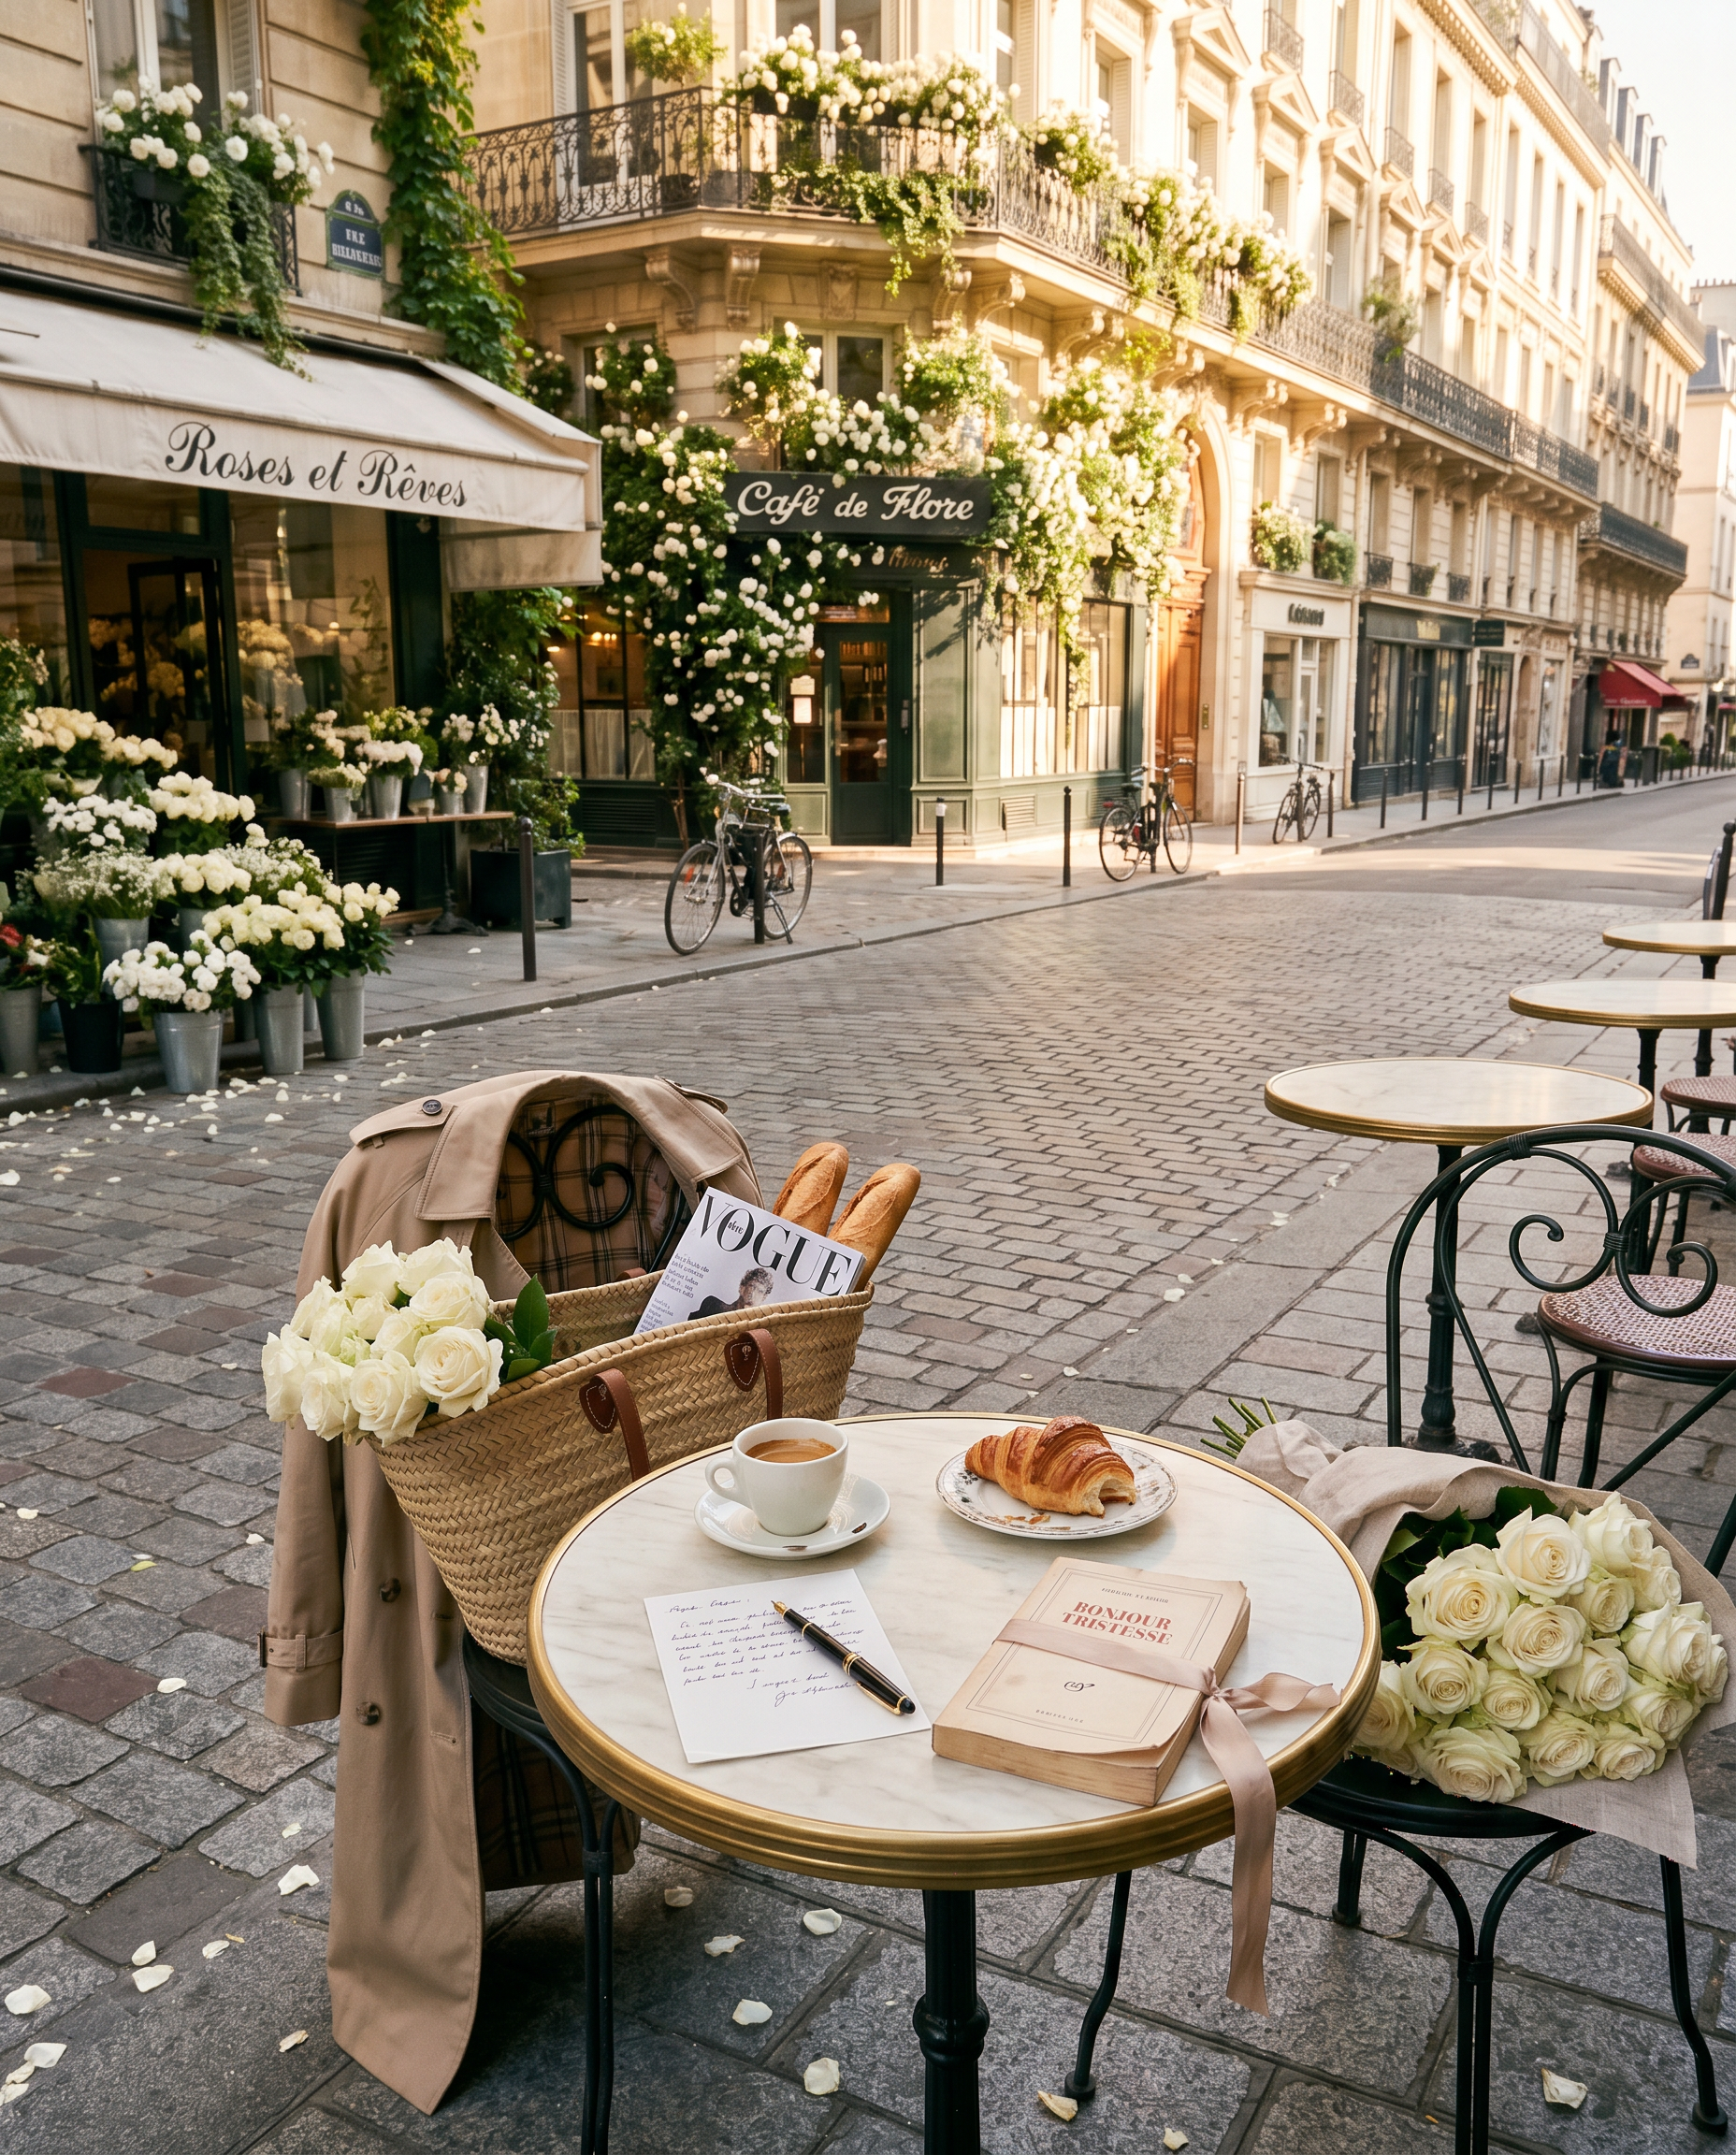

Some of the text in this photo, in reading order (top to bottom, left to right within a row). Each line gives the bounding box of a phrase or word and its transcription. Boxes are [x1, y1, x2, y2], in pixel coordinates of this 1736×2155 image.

[165, 421, 467, 507] Roses et Rêves
[737, 480, 974, 526] Café de Flore
[700, 1193, 852, 1297] VOGUE
[1062, 1612, 1173, 1645] TRISTESSE
[1073, 1600, 1172, 1630] BONJOUR
